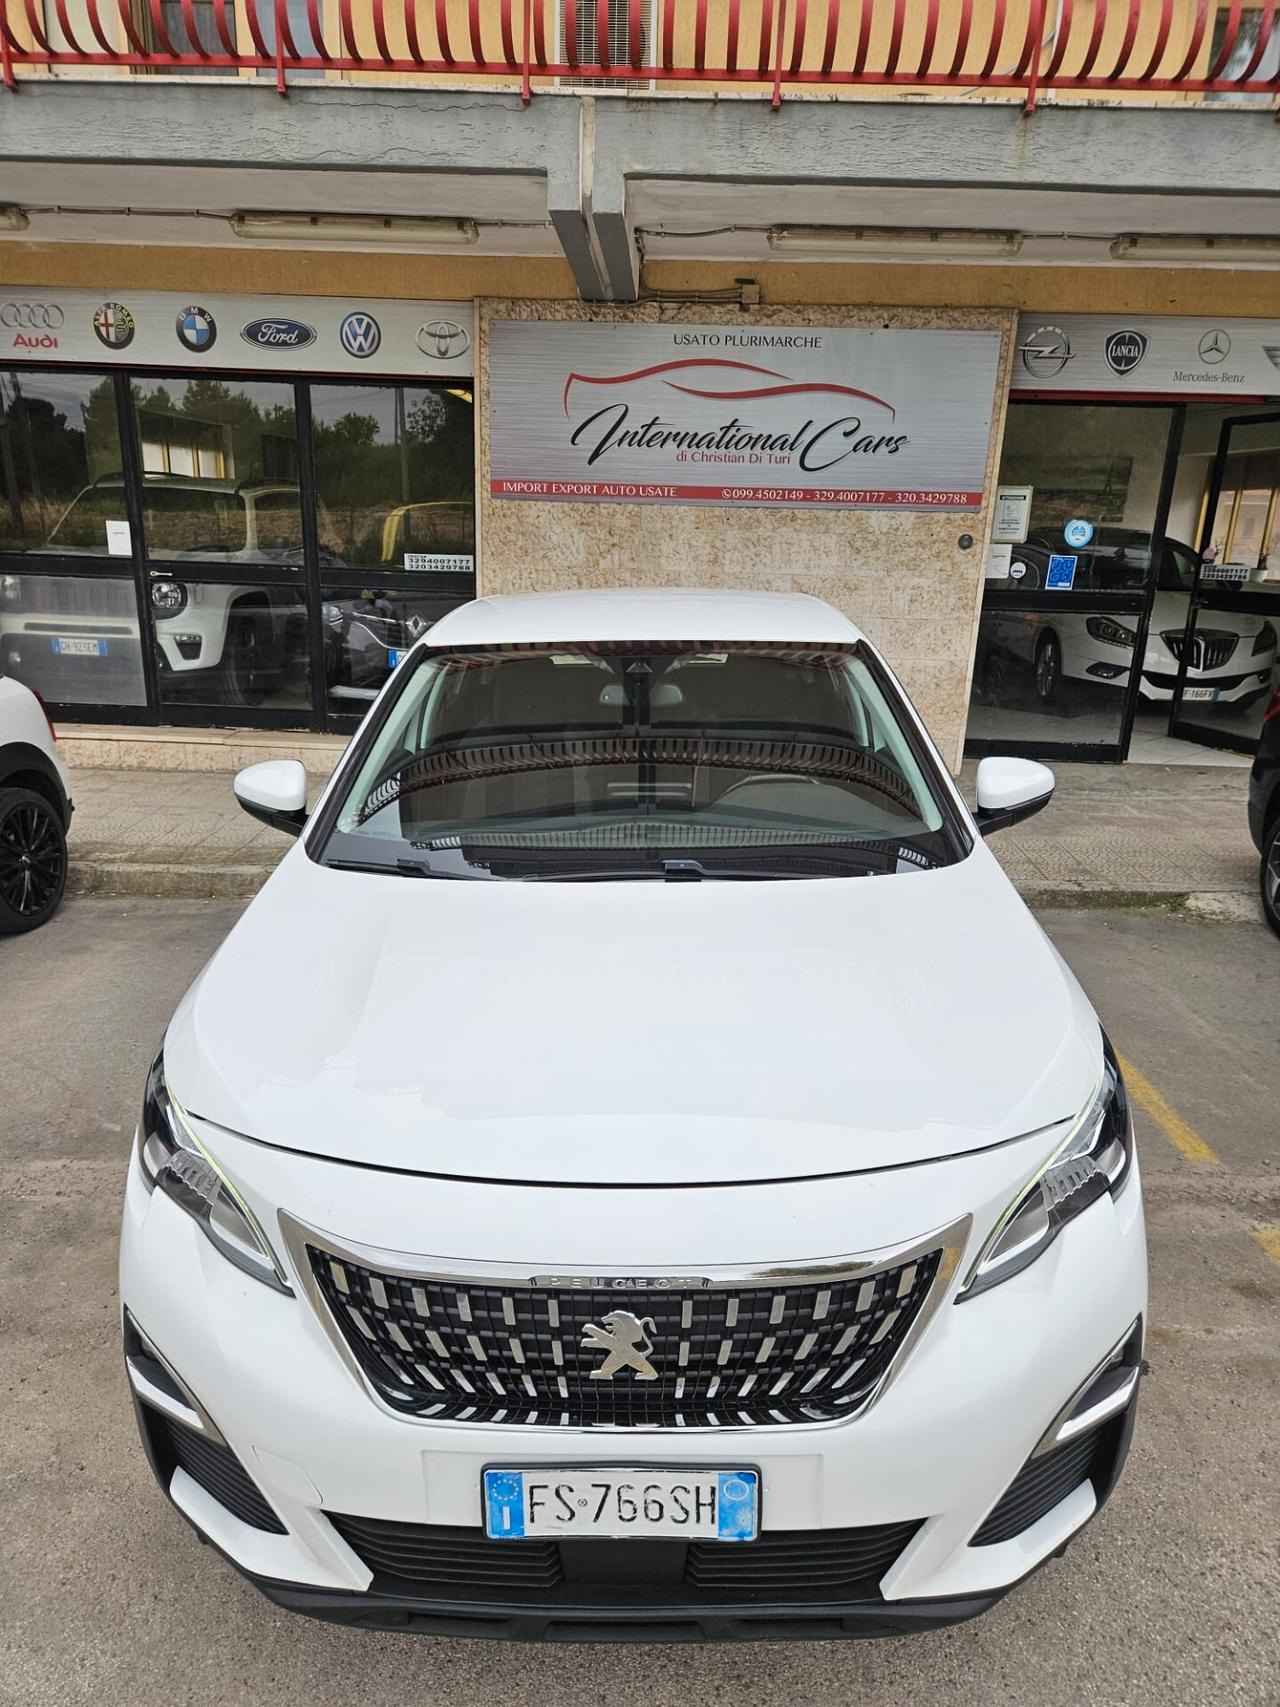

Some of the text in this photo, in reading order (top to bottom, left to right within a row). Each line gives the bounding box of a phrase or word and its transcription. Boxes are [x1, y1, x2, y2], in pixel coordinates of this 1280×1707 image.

[179, 307, 212, 321] BMW
[12, 333, 59, 348] Audi
[258, 322, 298, 345] Ford
[673, 333, 822, 349] USATO PLURIMARCHE
[1112, 345, 1139, 358] LANCIA
[1173, 371, 1246, 384] Mercedes-Benz
[570, 403, 910, 472] International Cars
[676, 451, 791, 465] di Christian Di Turi
[503, 482, 677, 497] IMPORT EXPORT AUTO USATE
[732, 488, 804, 500] 099.4502149
[813, 490, 885, 503] 329.4007177
[895, 492, 968, 505] 320.3429788
[550, 1277, 692, 1289] PEUGEOT
[528, 1484, 576, 1524] FS
[590, 1484, 717, 1525] 766SH
